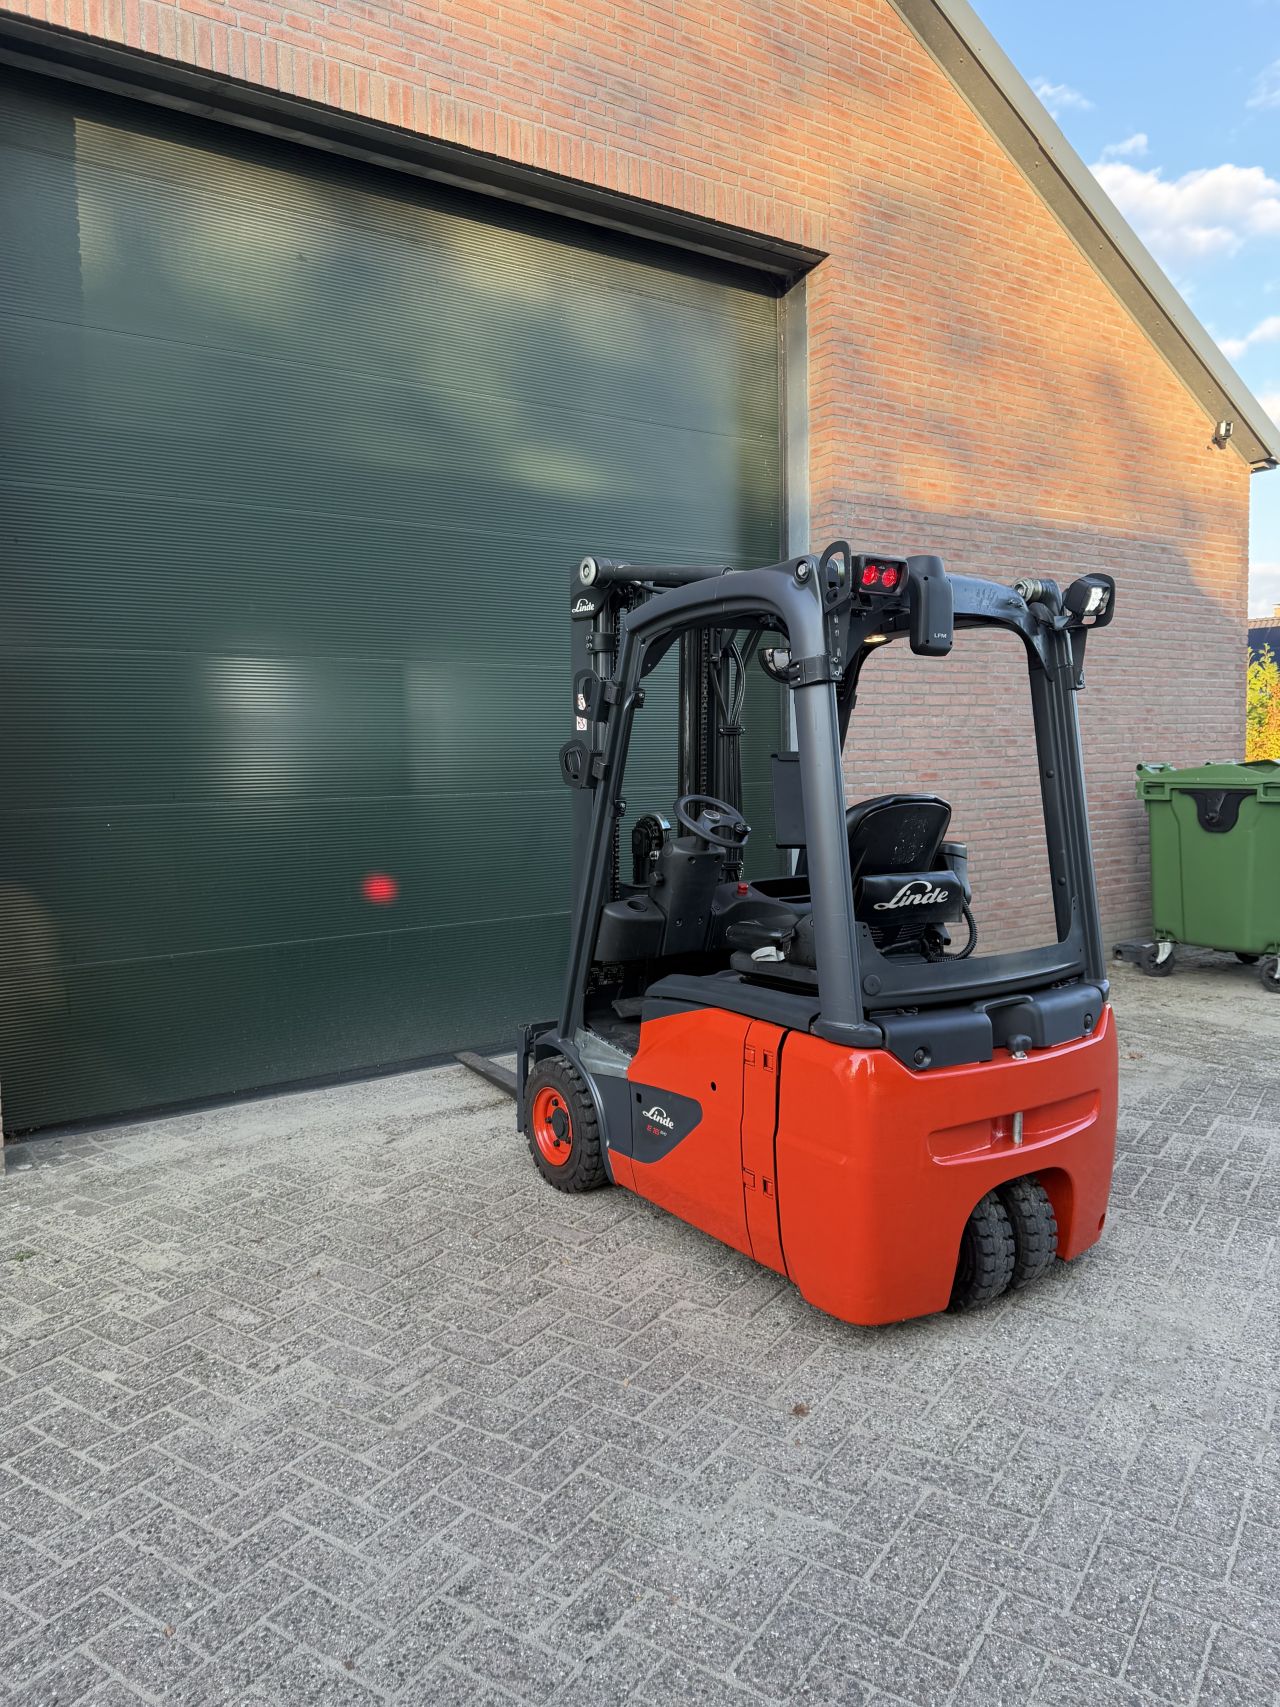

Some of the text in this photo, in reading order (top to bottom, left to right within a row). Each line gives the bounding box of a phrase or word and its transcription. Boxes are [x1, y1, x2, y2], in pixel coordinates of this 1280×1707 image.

[572, 598, 594, 613] Linde
[873, 880, 949, 910] Linde
[642, 1106, 674, 1129] Linde
